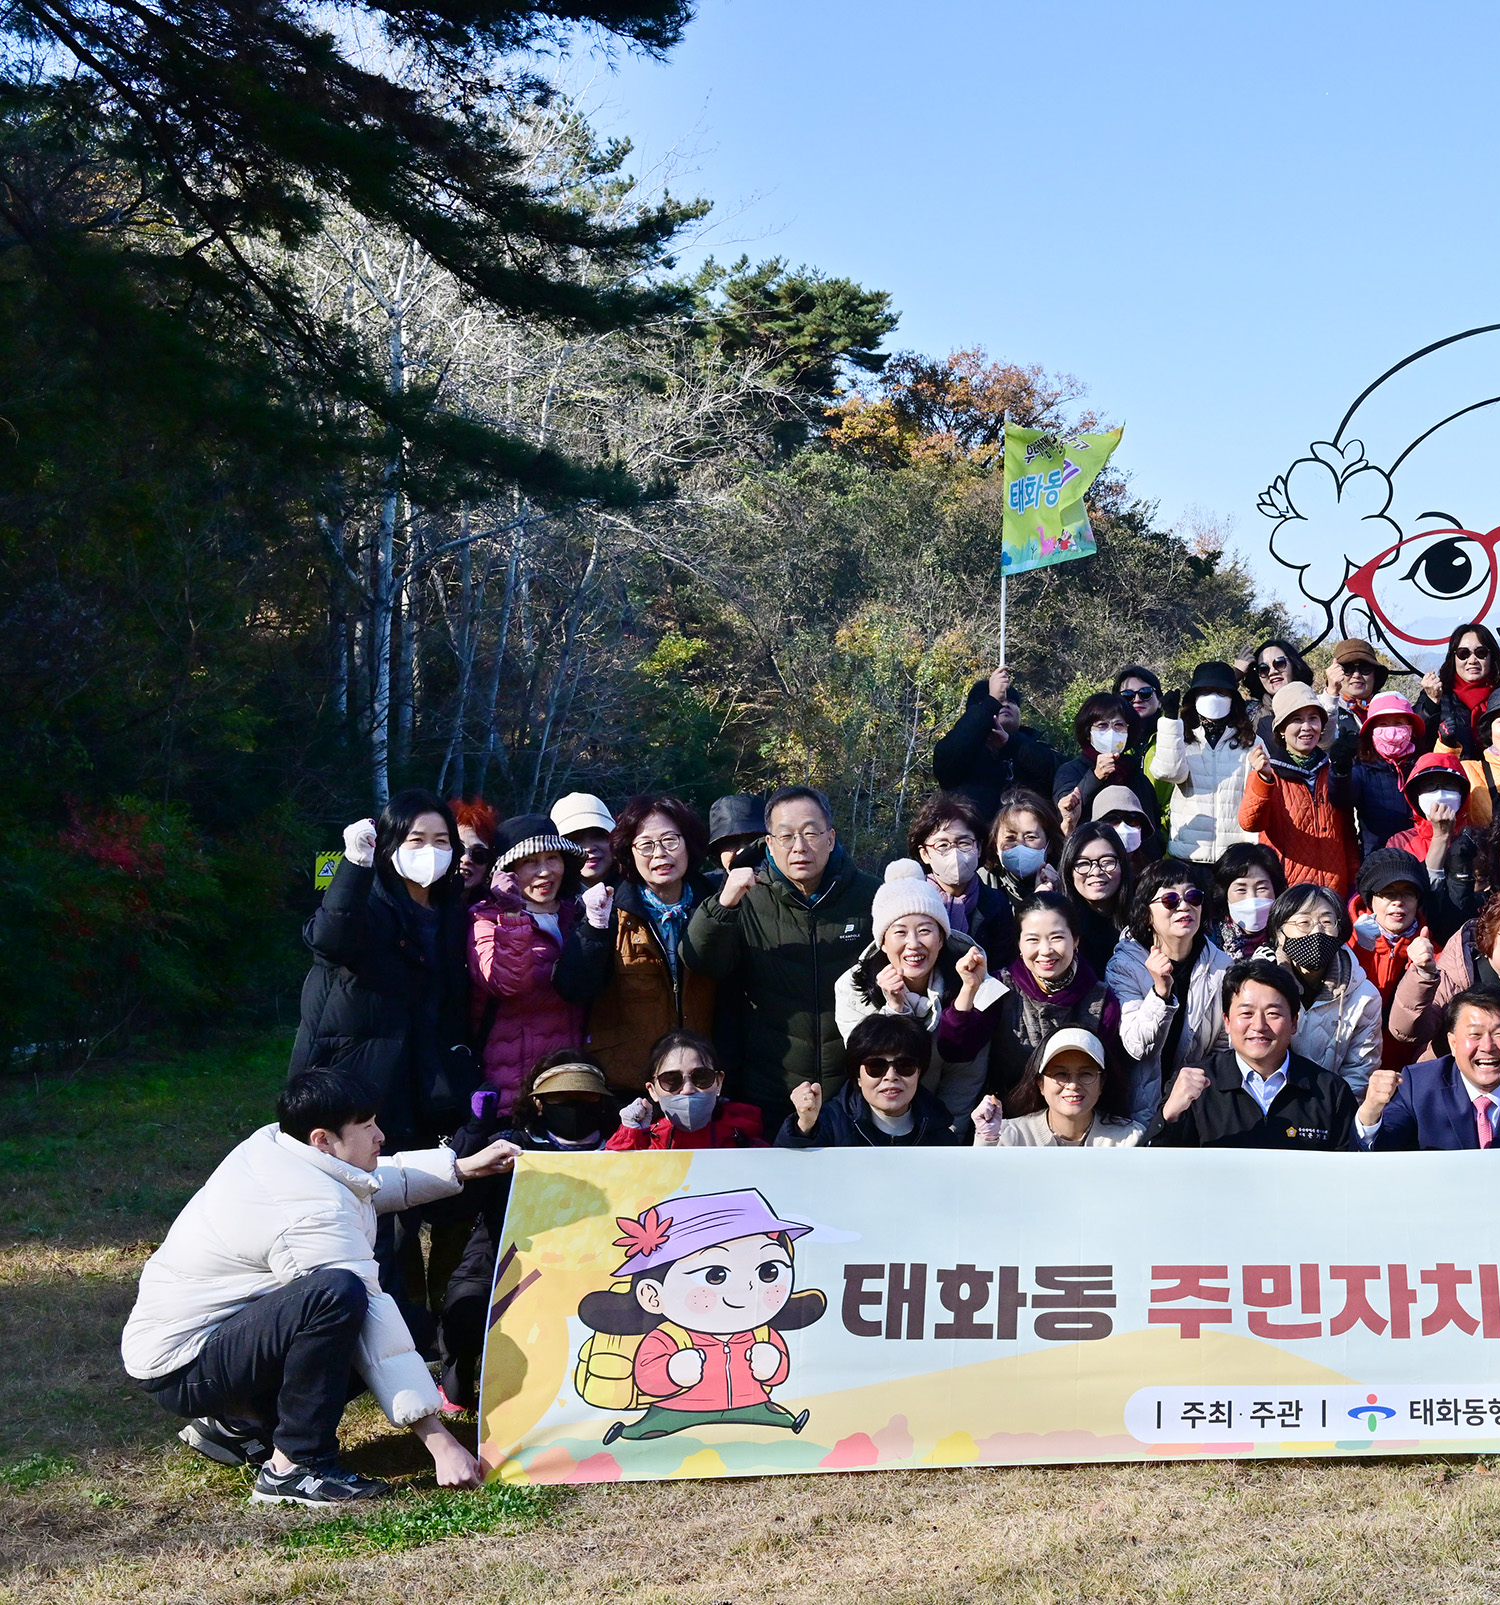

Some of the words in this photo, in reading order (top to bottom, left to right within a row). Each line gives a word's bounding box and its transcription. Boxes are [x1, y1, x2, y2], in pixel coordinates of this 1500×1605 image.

[1009, 469, 1062, 513] 태화동
[842, 1263, 1116, 1340] 태화동
[295, 1475, 324, 1495] N
